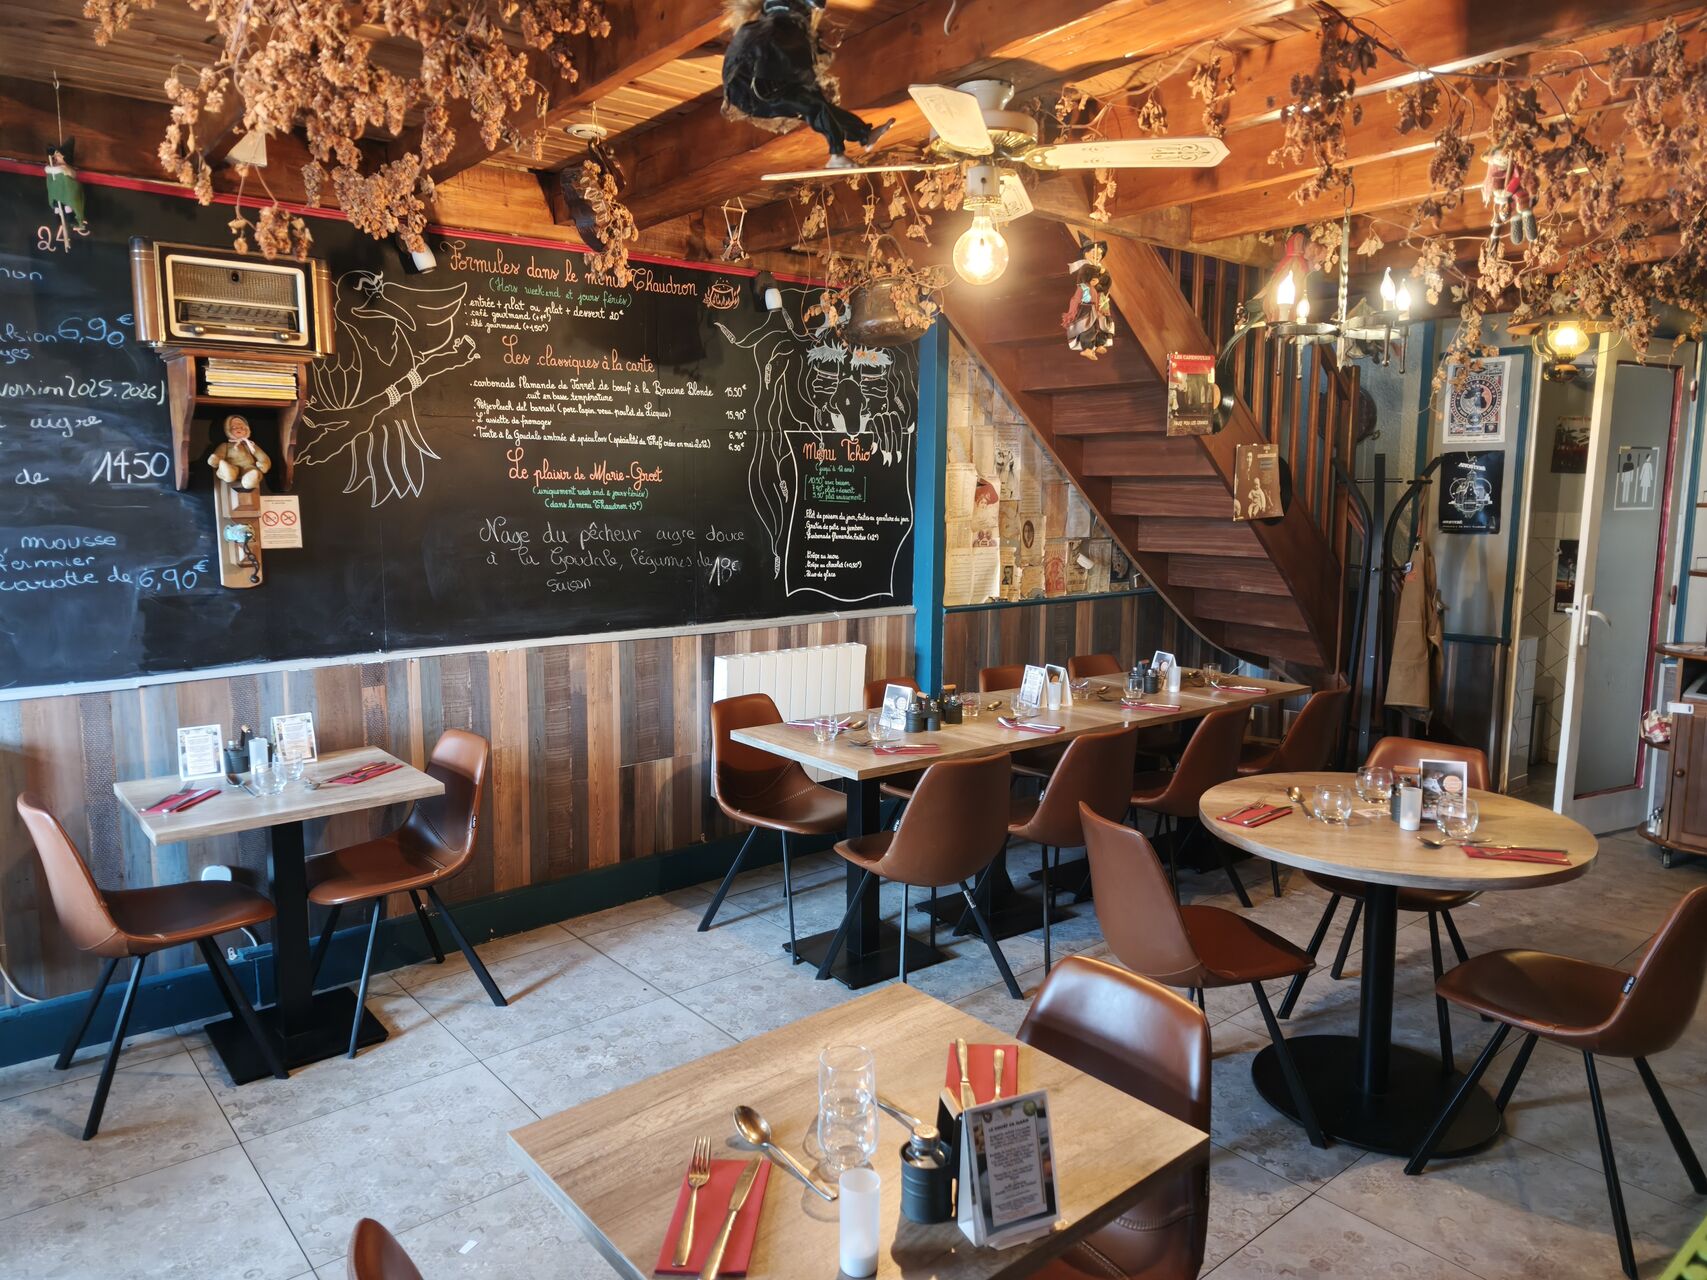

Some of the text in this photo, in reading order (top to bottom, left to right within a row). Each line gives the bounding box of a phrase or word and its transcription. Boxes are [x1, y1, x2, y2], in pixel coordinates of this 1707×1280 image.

[441, 240, 520, 275] Formules
[527, 256, 559, 280] dans
[565, 259, 578, 282] le
[565, 289, 573, 300] et
[469, 295, 496, 307] entrée
[503, 296, 525, 313] plat
[544, 301, 563, 317] plat
[573, 306, 606, 319] dessert
[492, 311, 531, 323] gourmand
[485, 322, 521, 334] gourmand
[502, 334, 655, 375] Les classiques à la carte
[558, 379, 569, 390] de
[597, 380, 610, 391] de
[642, 381, 651, 394] la
[803, 442, 836, 461] Menu
[15, 468, 49, 485] de
[507, 447, 529, 479] Le
[533, 458, 571, 487] plaisir
[574, 466, 585, 480] de
[480, 516, 745, 550] Nage du pêcheur aigre douce
[486, 552, 498, 566] à
[630, 548, 692, 574] légumes
[107, 565, 132, 583] de
